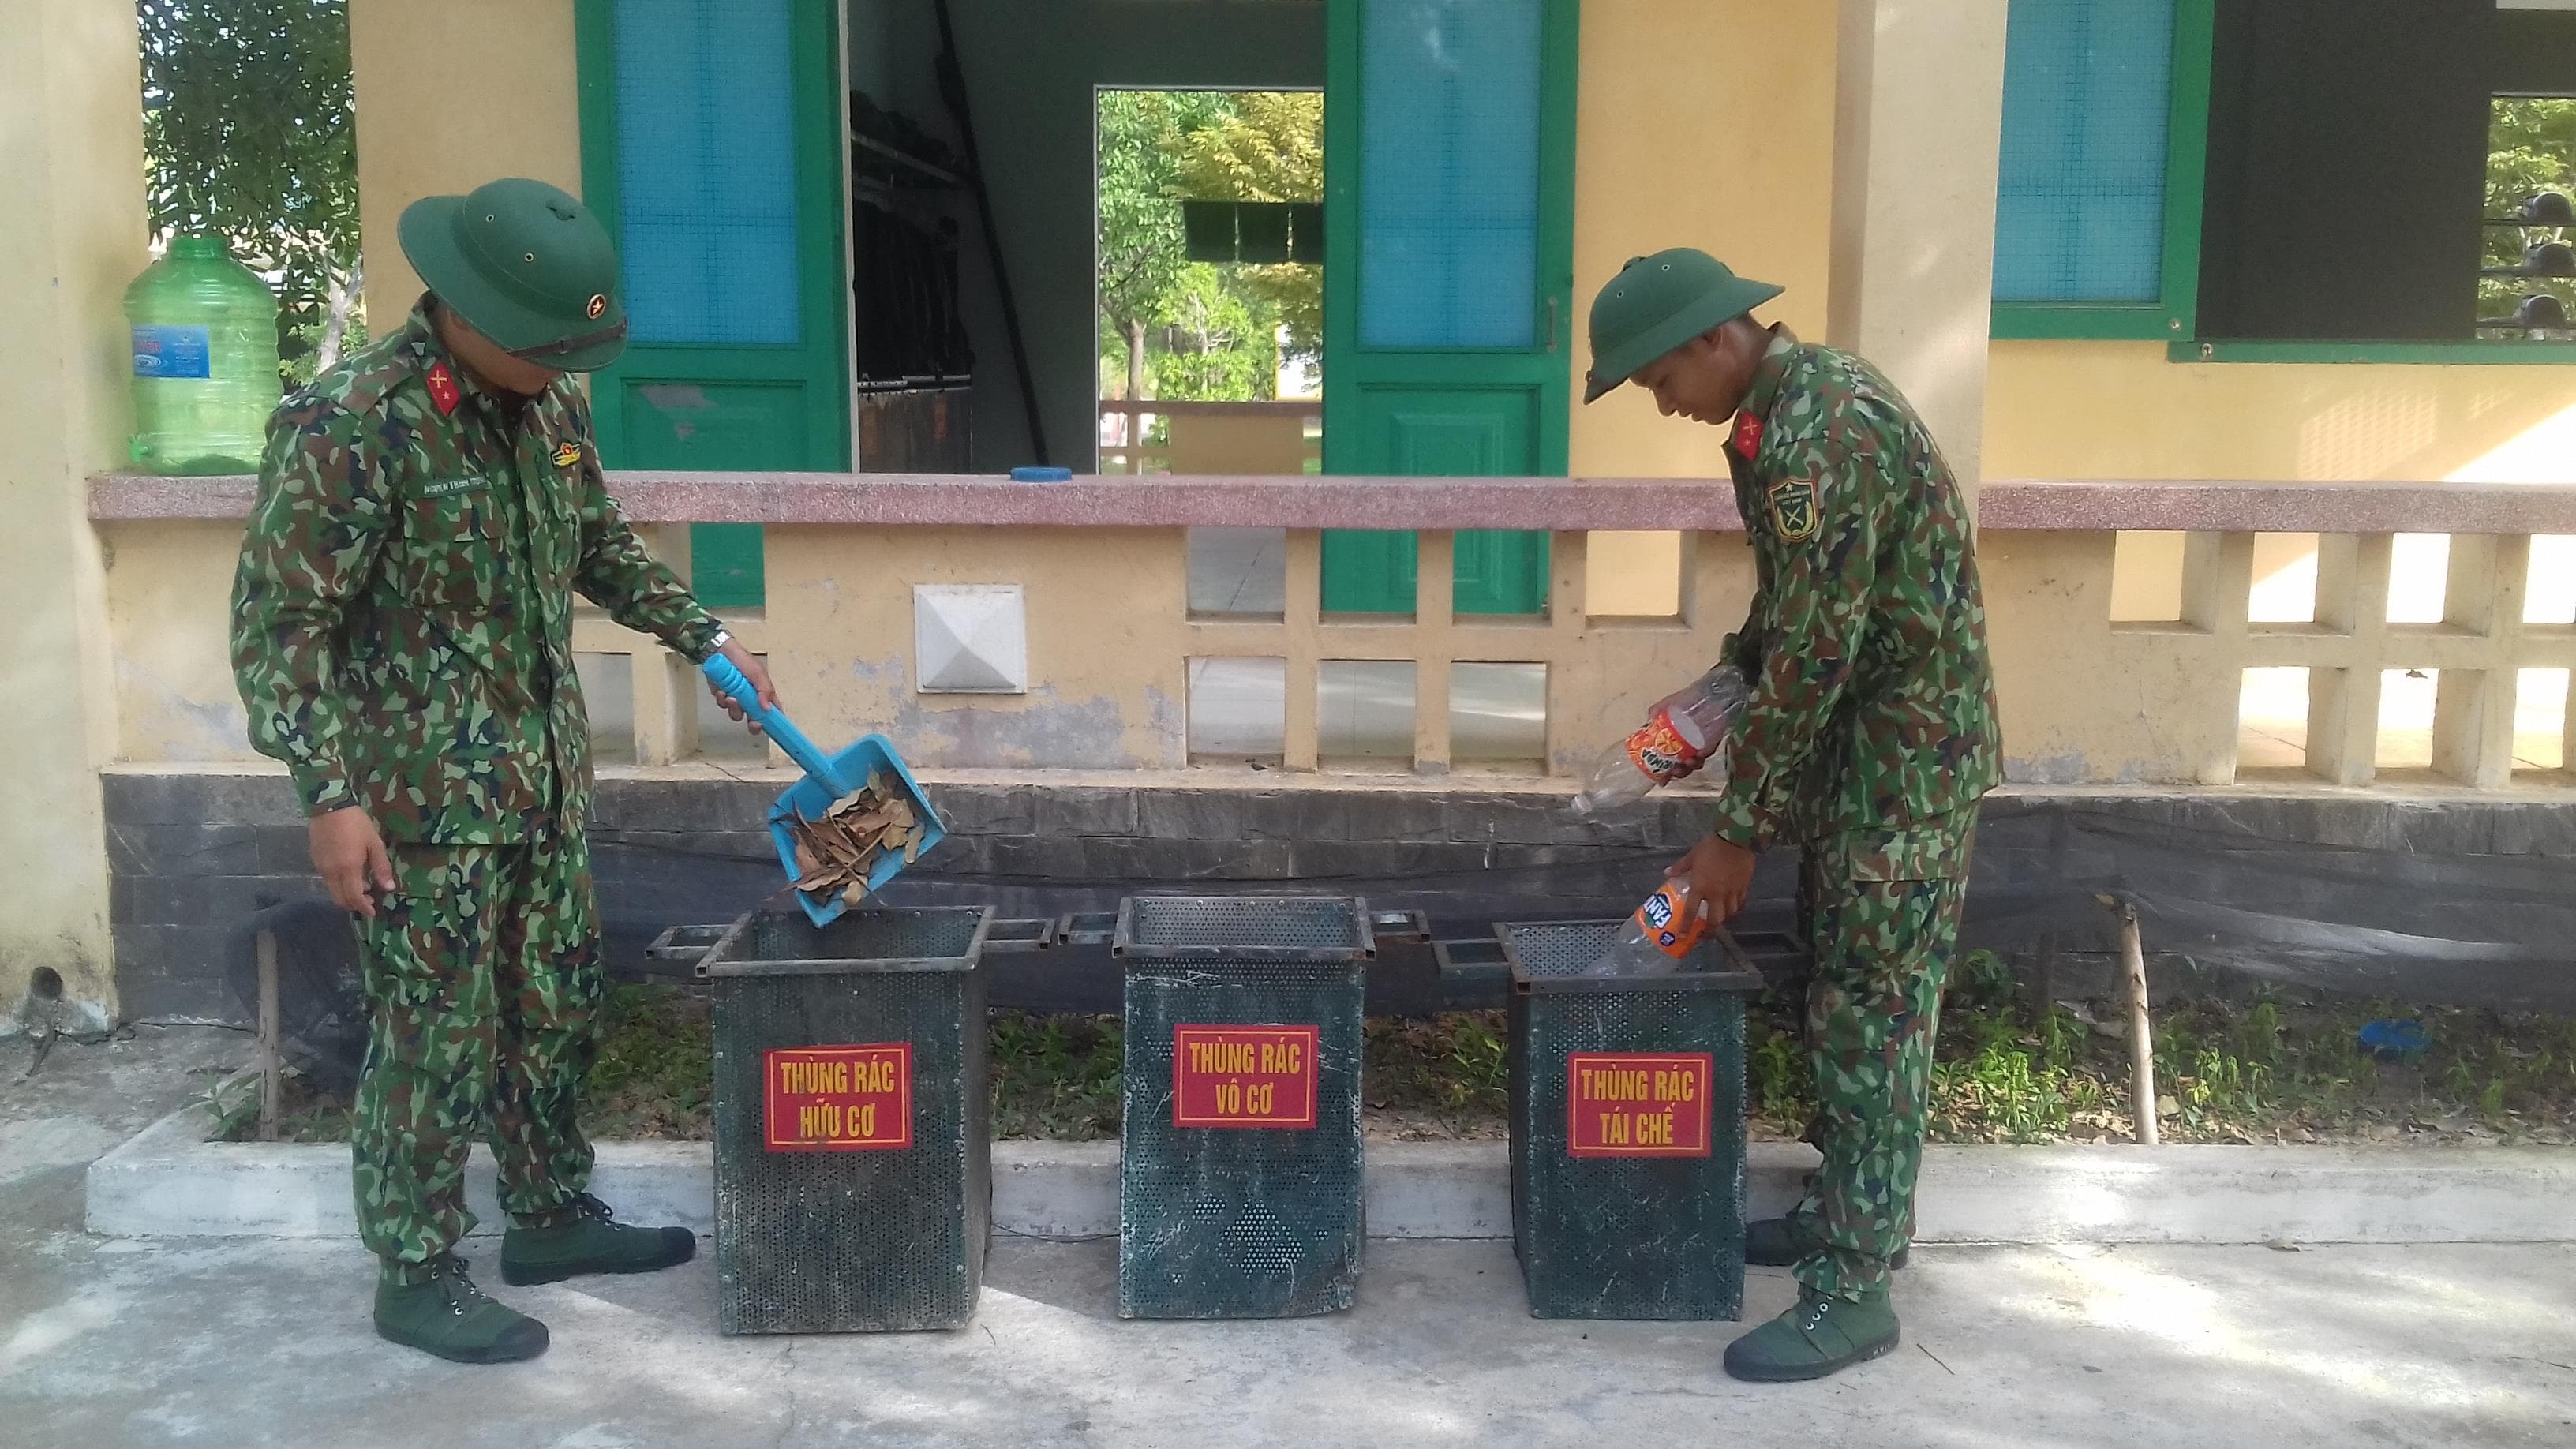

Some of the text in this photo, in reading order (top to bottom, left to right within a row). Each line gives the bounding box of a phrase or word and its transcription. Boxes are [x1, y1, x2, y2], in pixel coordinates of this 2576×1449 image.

[780, 1054, 895, 1094] THÙNG RÁC
[1189, 1036, 1301, 1074] THÙNG RÁC
[1215, 1077, 1275, 1115] VÔ CƠ
[1580, 1063, 1694, 1101] THÙNG RÁC
[799, 1098, 877, 1138] HỮU CƠ
[1599, 1102, 1676, 1144] TÁI CHẾ
